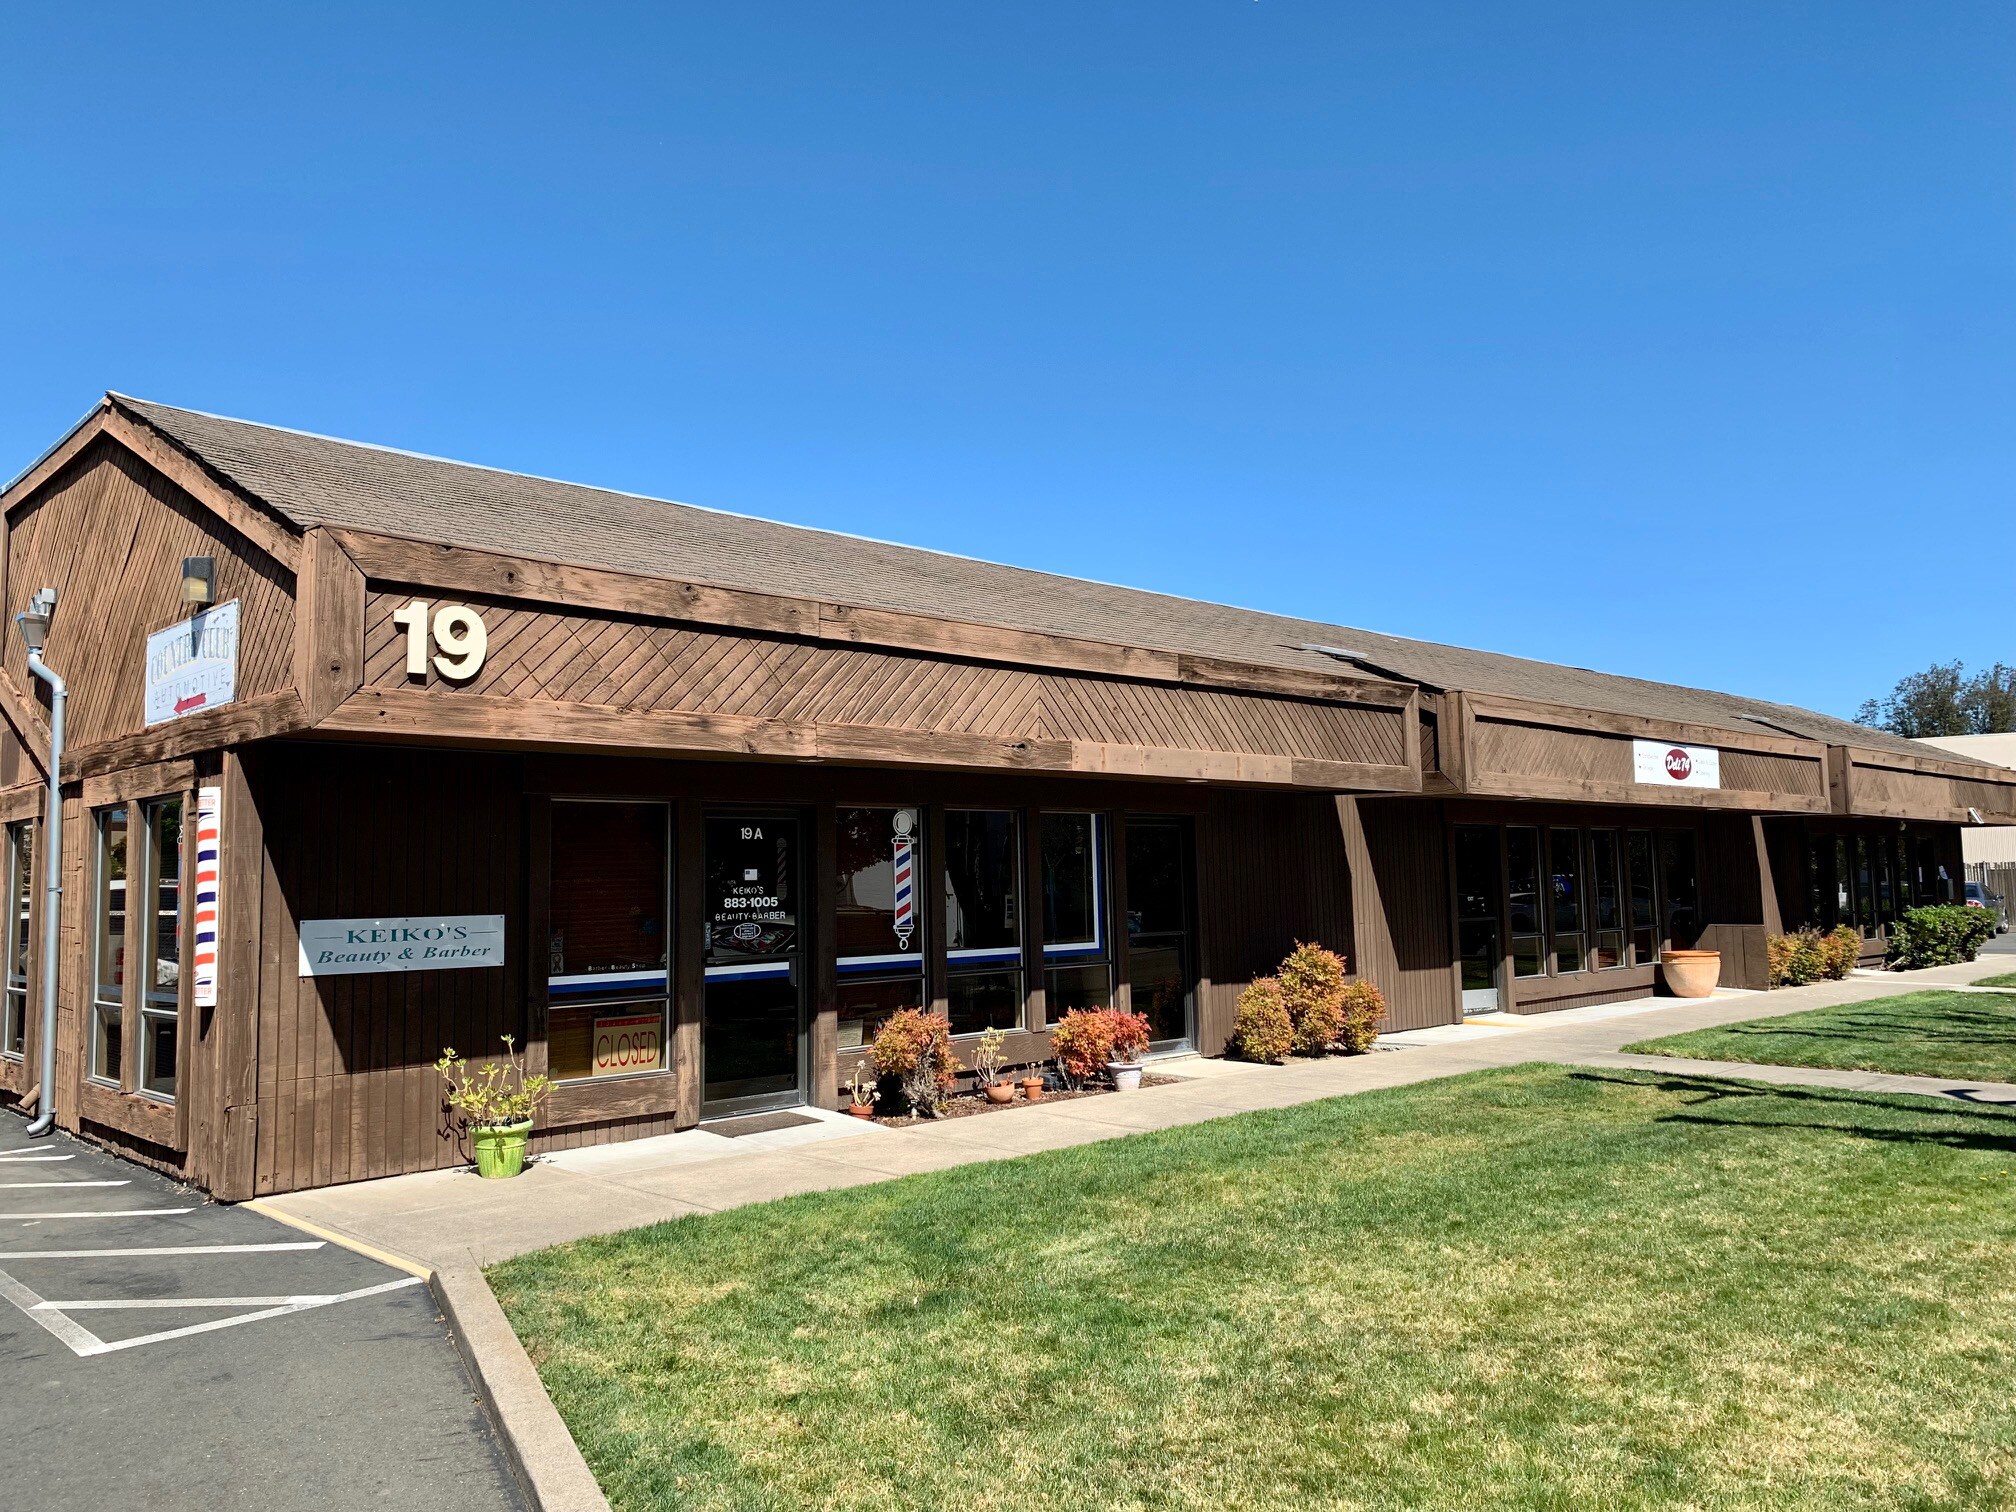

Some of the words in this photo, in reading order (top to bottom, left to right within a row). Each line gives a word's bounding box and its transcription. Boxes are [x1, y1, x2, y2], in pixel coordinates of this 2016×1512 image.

[202, 626, 231, 660] CLUB
[393, 600, 488, 680] 19
[740, 827, 752, 840] 19
[753, 827, 763, 840] A
[732, 886, 764, 895] KEIKO'S
[723, 896, 779, 908] 883-1005
[346, 926, 468, 945] KEIKO'S
[317, 950, 391, 965] Beauty
[397, 947, 414, 960] &
[423, 946, 491, 960] Barber
[596, 1030, 658, 1068] CLOSED
